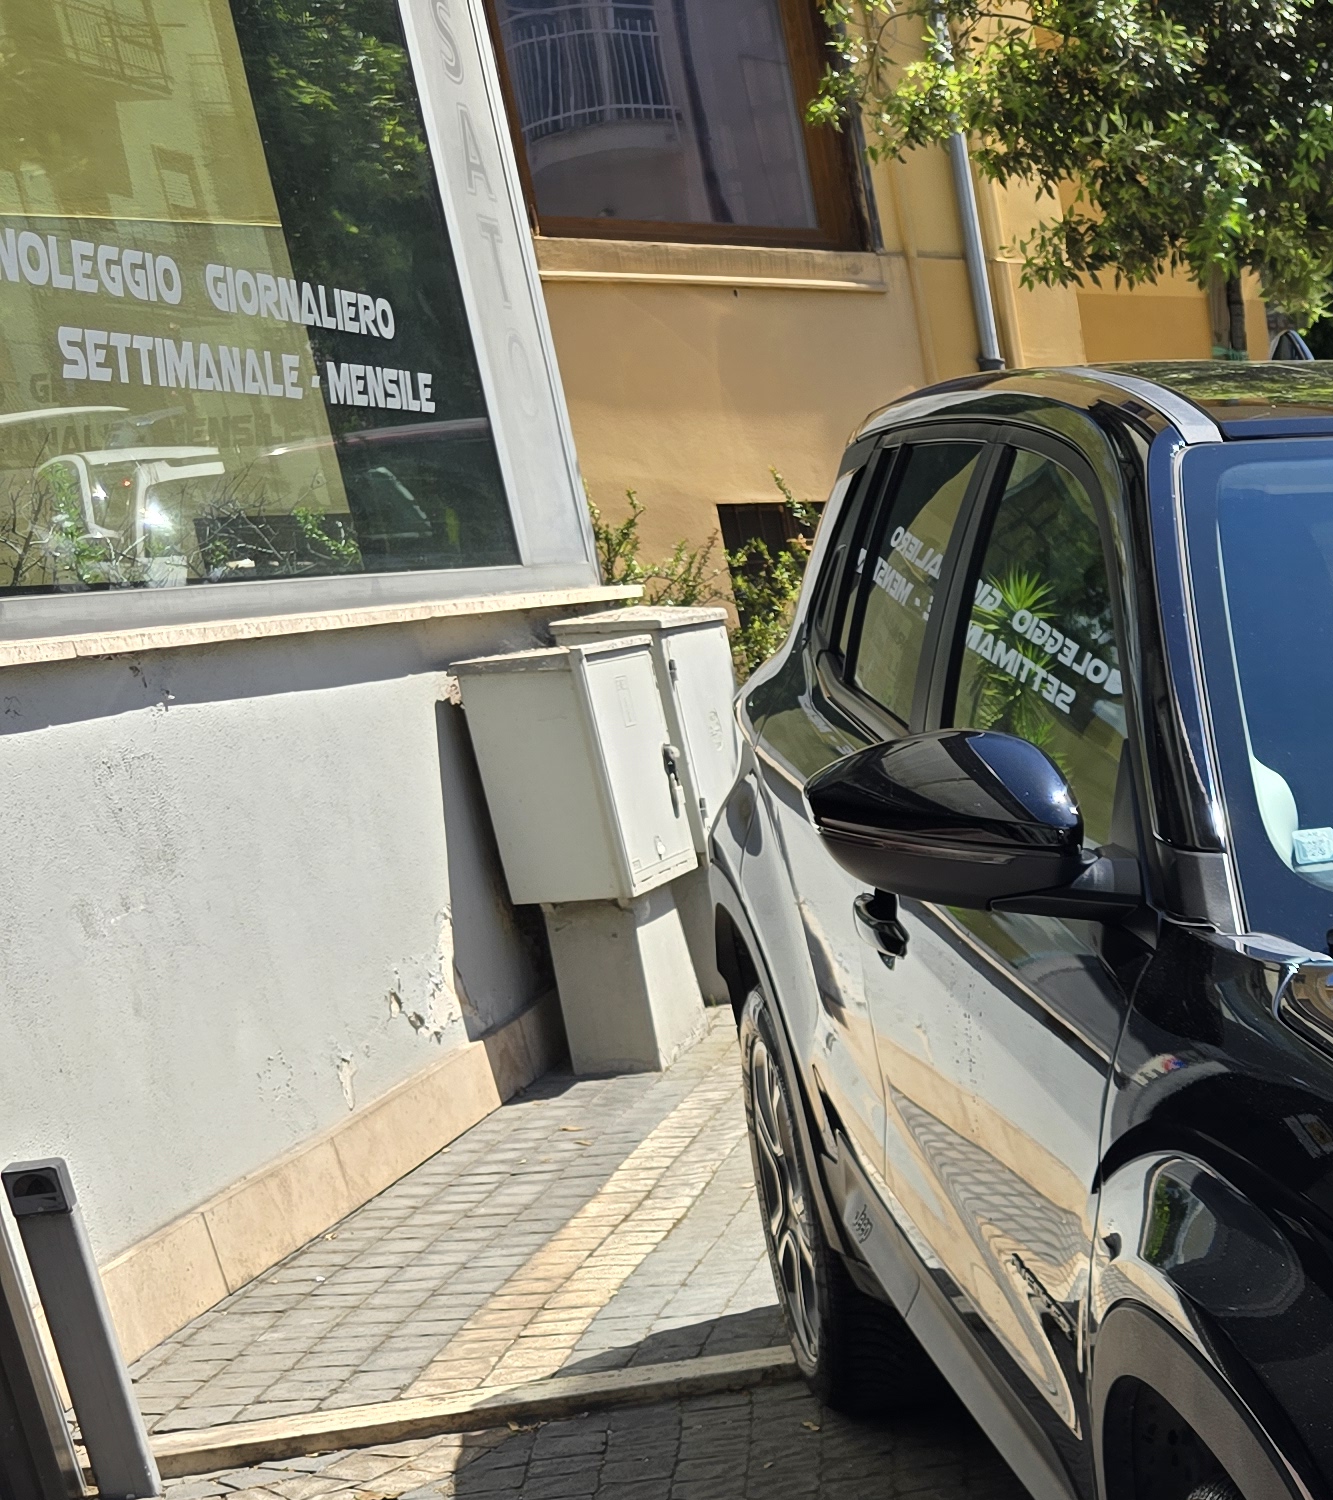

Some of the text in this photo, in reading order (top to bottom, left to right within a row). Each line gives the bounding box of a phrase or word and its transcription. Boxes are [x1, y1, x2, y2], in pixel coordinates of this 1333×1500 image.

[0, 228, 395, 340] NOLEGGIO GIORNALIERO
[57, 326, 303, 399] SETTIMANALE
[327, 360, 436, 413] MENSILE
